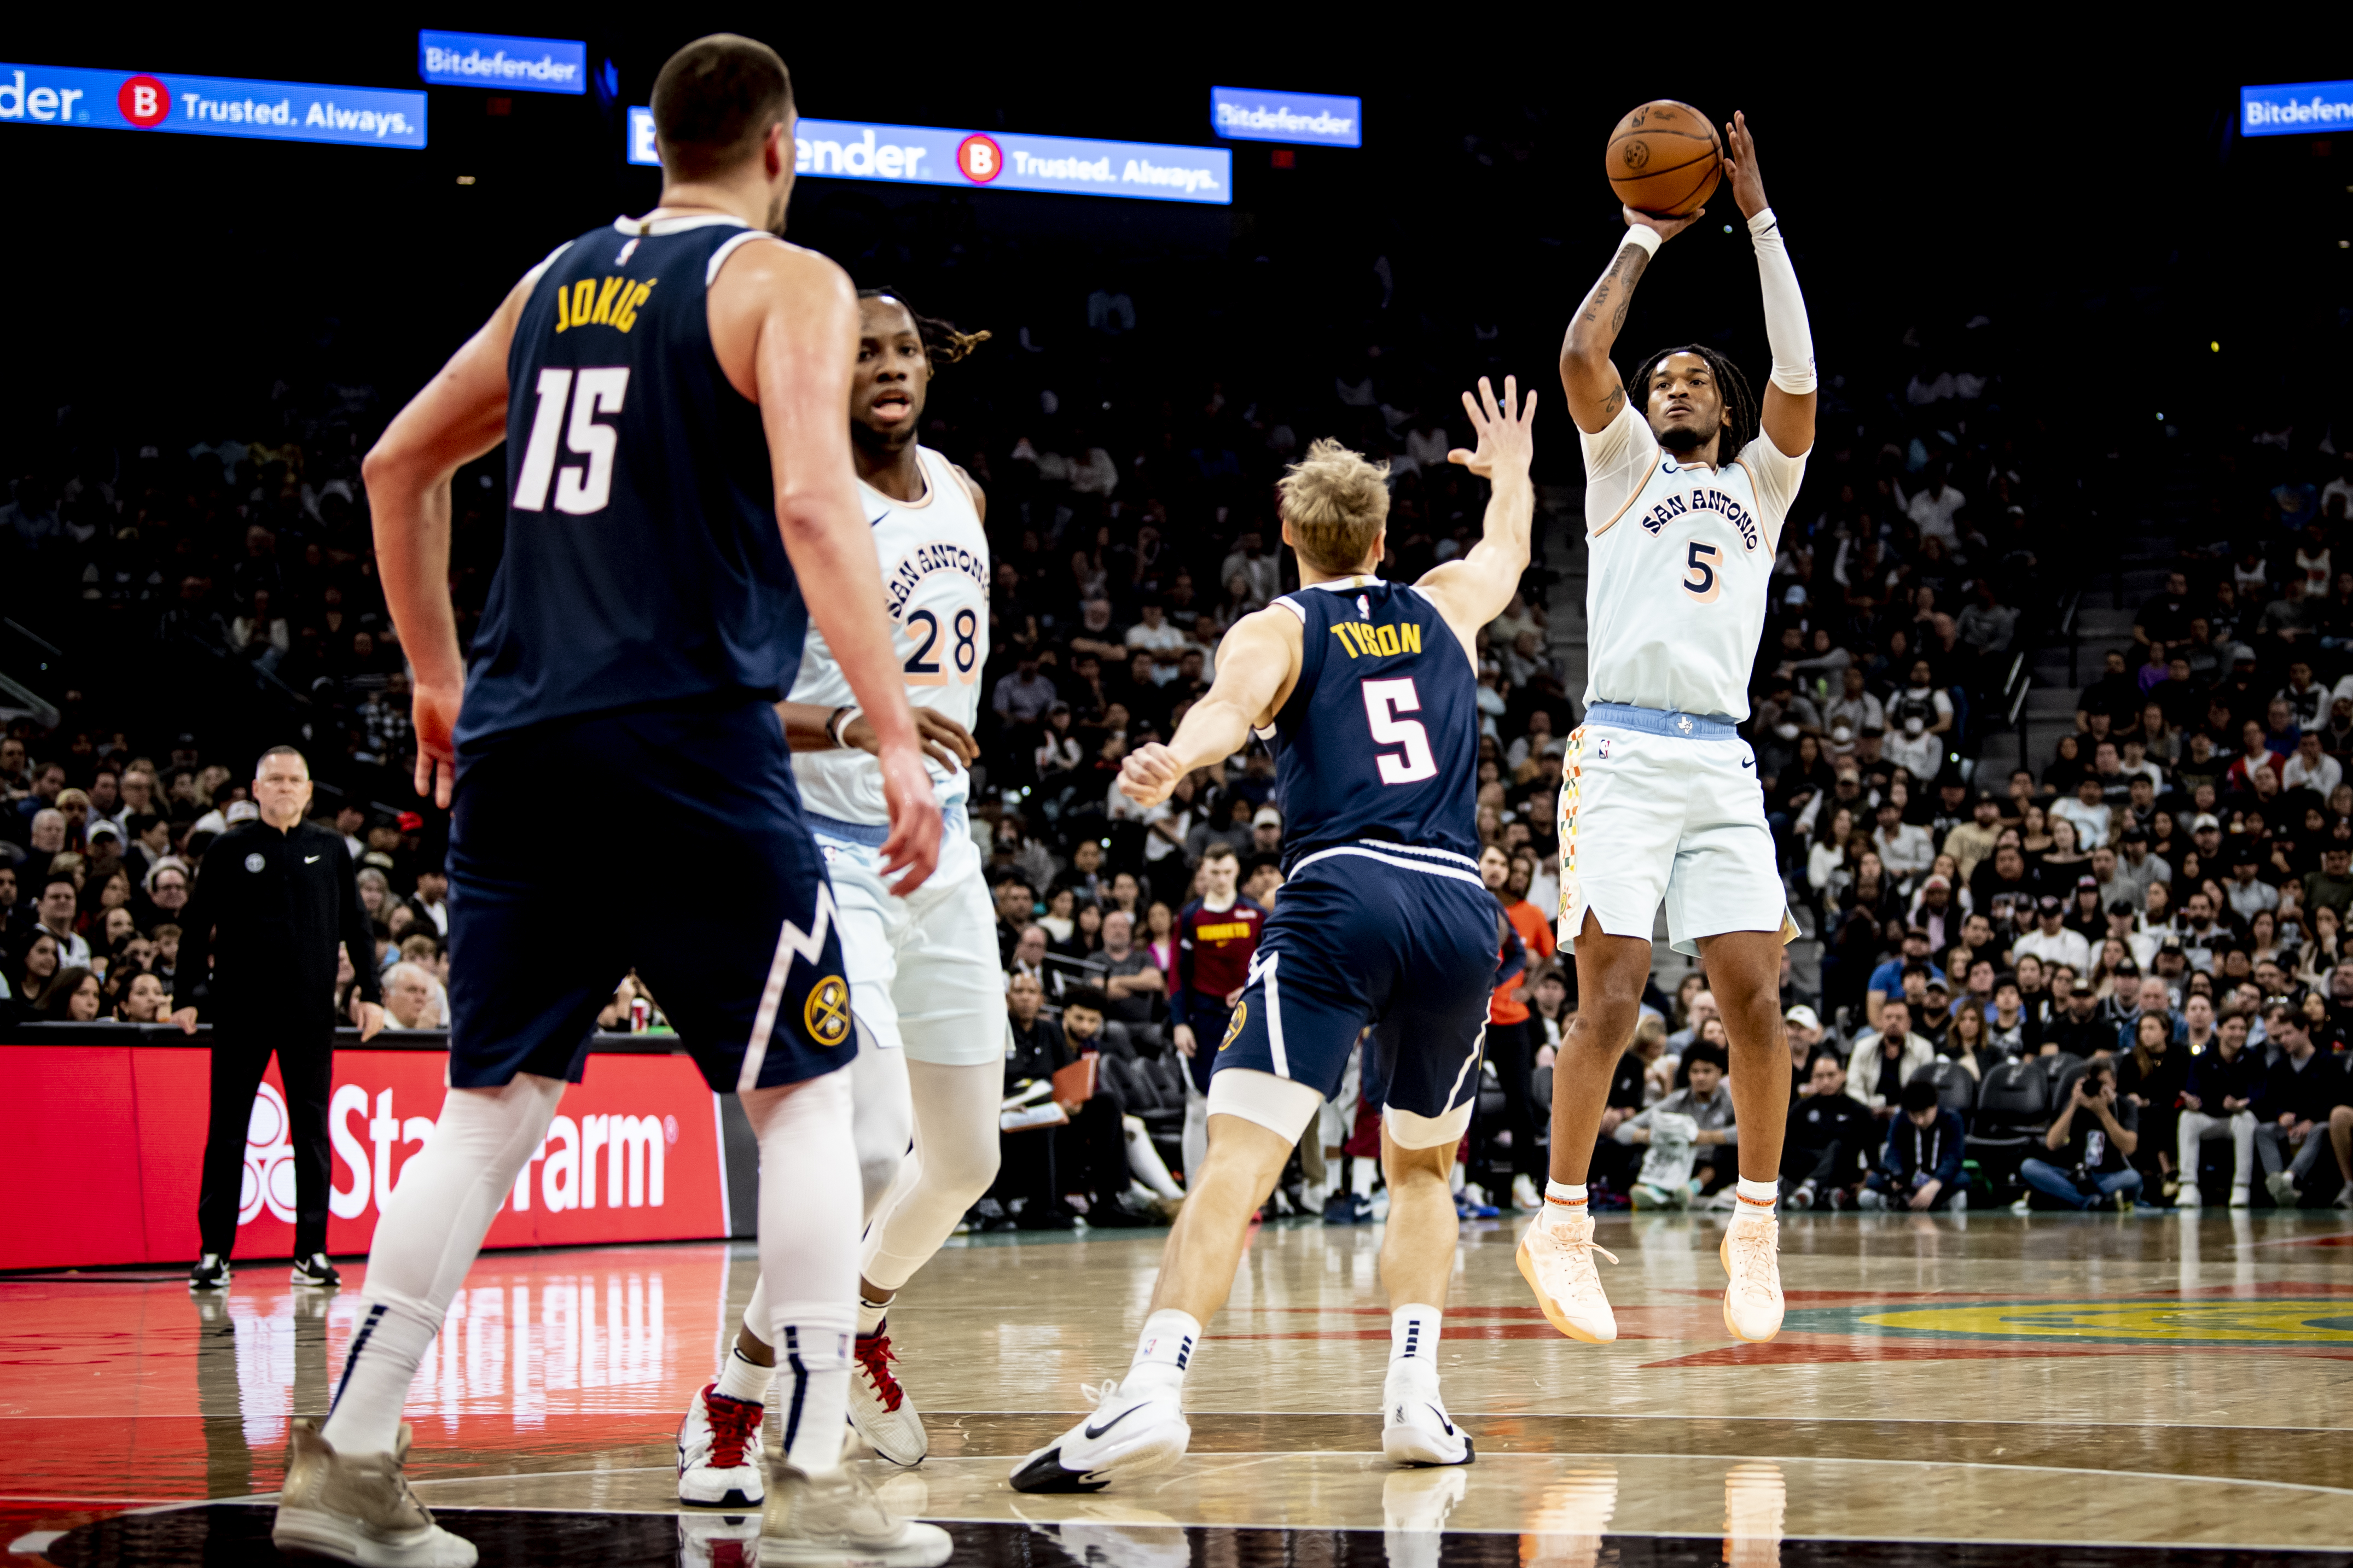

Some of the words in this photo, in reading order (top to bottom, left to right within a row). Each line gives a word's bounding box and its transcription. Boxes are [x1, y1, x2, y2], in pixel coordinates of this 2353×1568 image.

[424, 46, 577, 82] Bitdefender
[133, 85, 158, 118] B
[181, 93, 299, 126] Trusted.
[305, 102, 415, 138] Always.
[1216, 103, 1353, 136] Bitdefender
[969, 144, 993, 174] B
[1012, 150, 1116, 183] Trusted.
[1122, 159, 1219, 193] Always.
[556, 276, 657, 334] JOKIĆ
[512, 367, 630, 515] 15
[1641, 493, 1684, 535] SAN
[1691, 488, 1758, 551] ANTONIO
[885, 559, 921, 619] SAN
[1683, 541, 1719, 598] 5
[904, 608, 977, 678] 28
[1330, 622, 1421, 658] TYSON
[1361, 676, 1439, 786] 5
